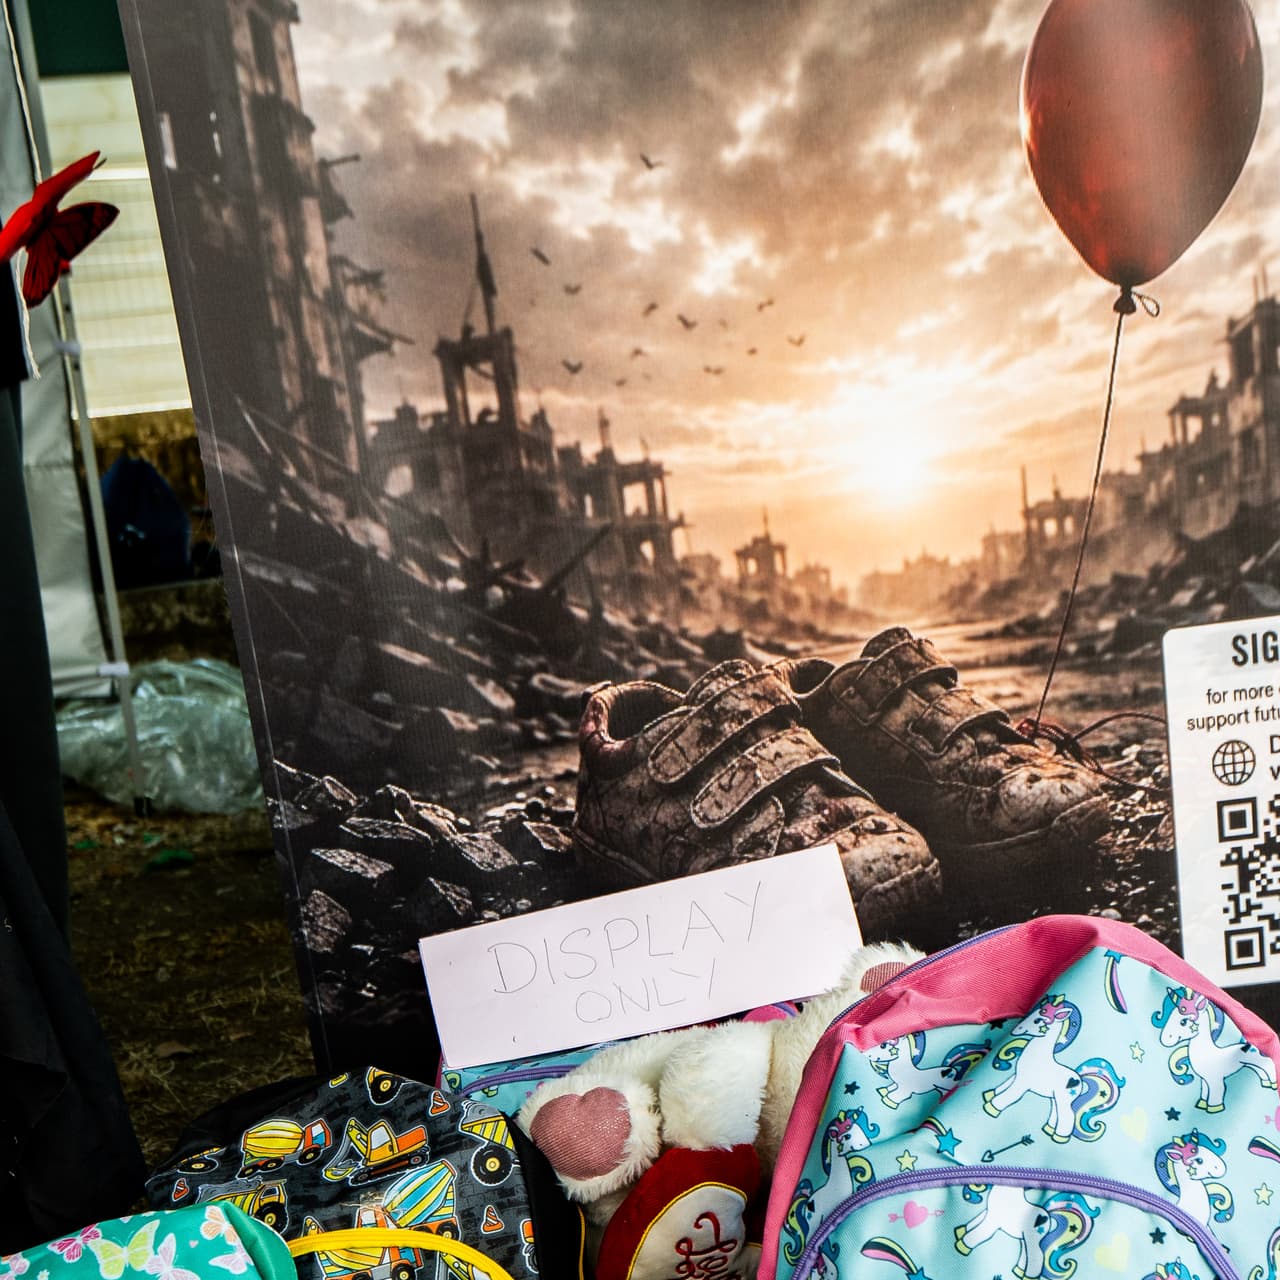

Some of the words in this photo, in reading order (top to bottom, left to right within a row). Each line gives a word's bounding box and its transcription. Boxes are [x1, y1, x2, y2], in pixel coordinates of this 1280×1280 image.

[1206, 688, 1228, 704] for
[1234, 683, 1274, 703] more
[1187, 710, 1250, 732] support
[487, 880, 762, 994] DISPLAY
[575, 957, 716, 1024] ONLY
